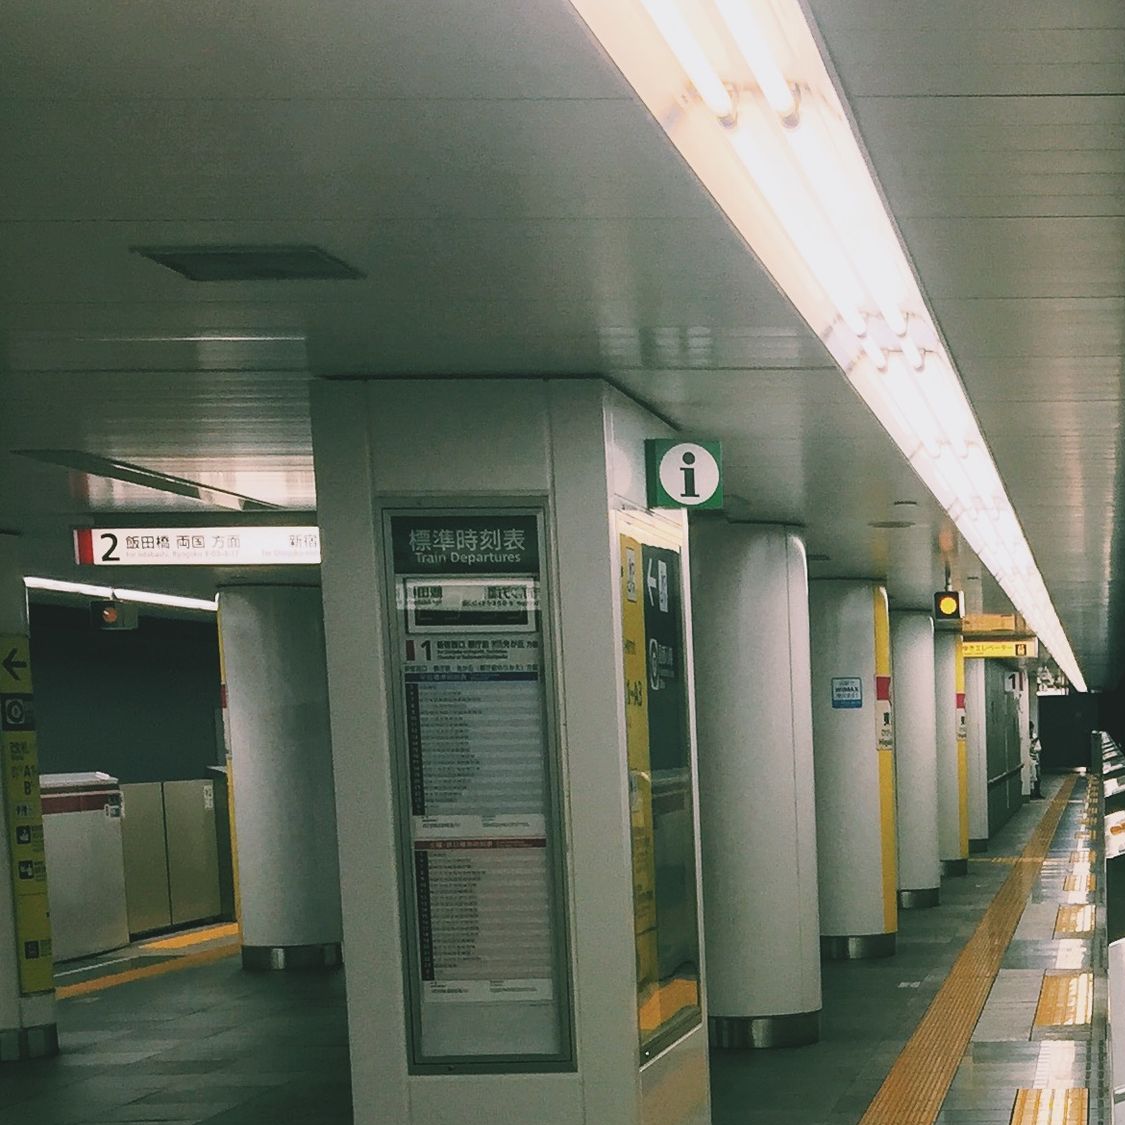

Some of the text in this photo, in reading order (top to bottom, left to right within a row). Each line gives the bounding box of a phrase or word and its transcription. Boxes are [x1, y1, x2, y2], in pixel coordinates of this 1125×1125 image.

[100, 533, 120, 561] 2
[126, 535, 170, 549] 飯田橋
[176, 535, 205, 549] 両国
[212, 535, 240, 549] 方面
[409, 528, 526, 551] 標準時刻表
[415, 552, 521, 566] Train Departures
[421, 640, 431, 661] 1
[1008, 673, 1016, 690] 1
